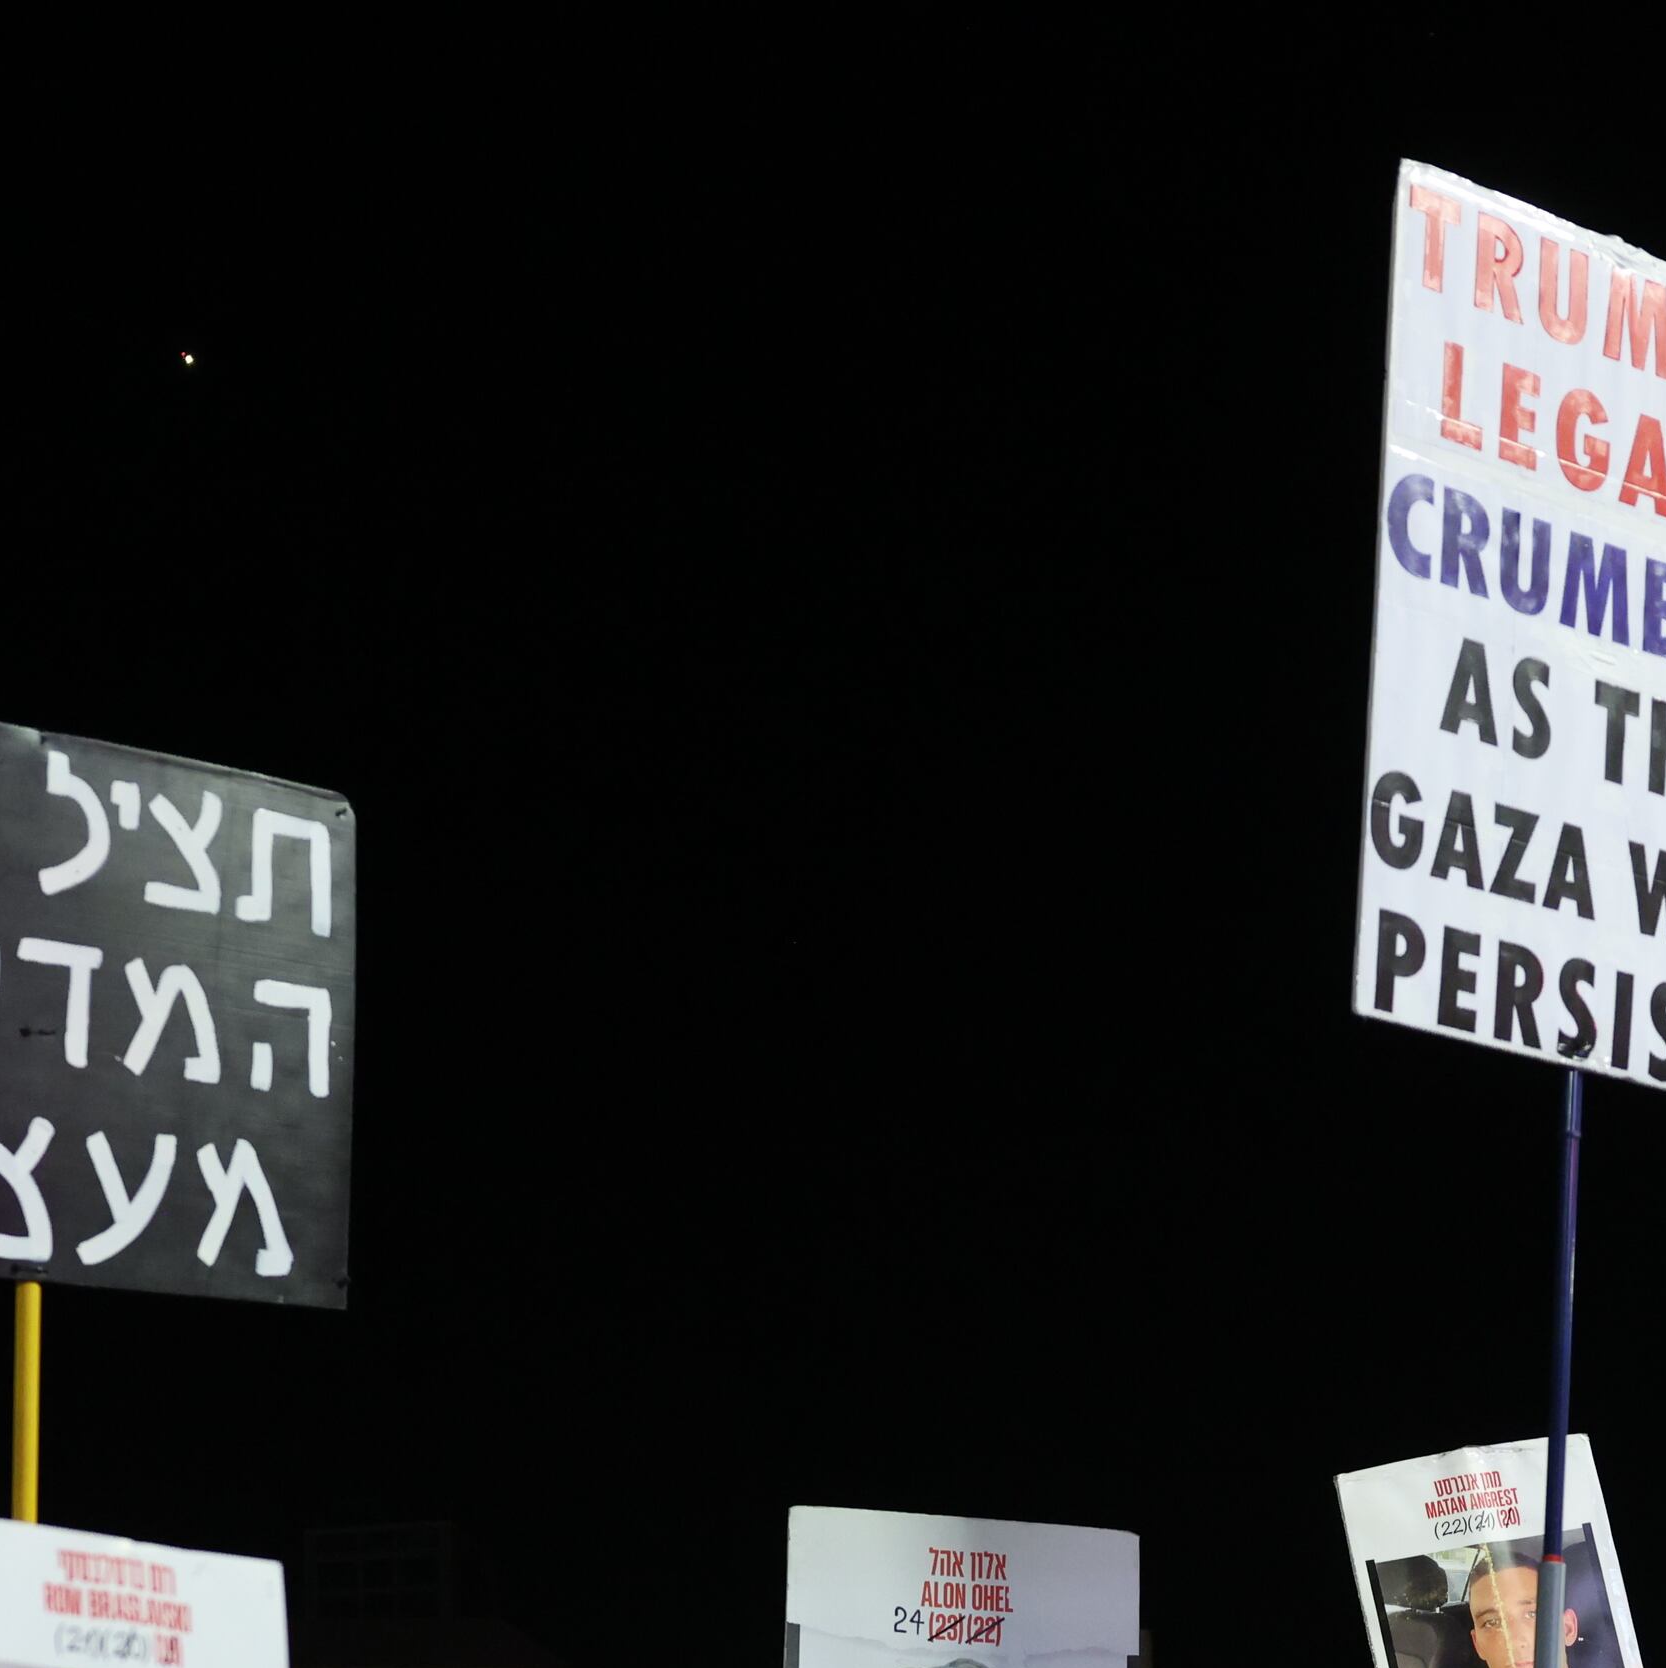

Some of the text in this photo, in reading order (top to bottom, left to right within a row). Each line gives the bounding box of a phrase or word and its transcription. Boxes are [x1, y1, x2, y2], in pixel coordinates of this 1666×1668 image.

[1439, 636, 1552, 760] AS
[38, 750, 331, 937] תציל
[1370, 770, 1595, 921] GAZA
[1481, 1471, 1502, 1490] מתן
[1425, 1488, 1519, 1519] MATAN ANGREST
[928, 1546, 1007, 1581] אלון אהל
[921, 1580, 1014, 1614] ALON OHEL
